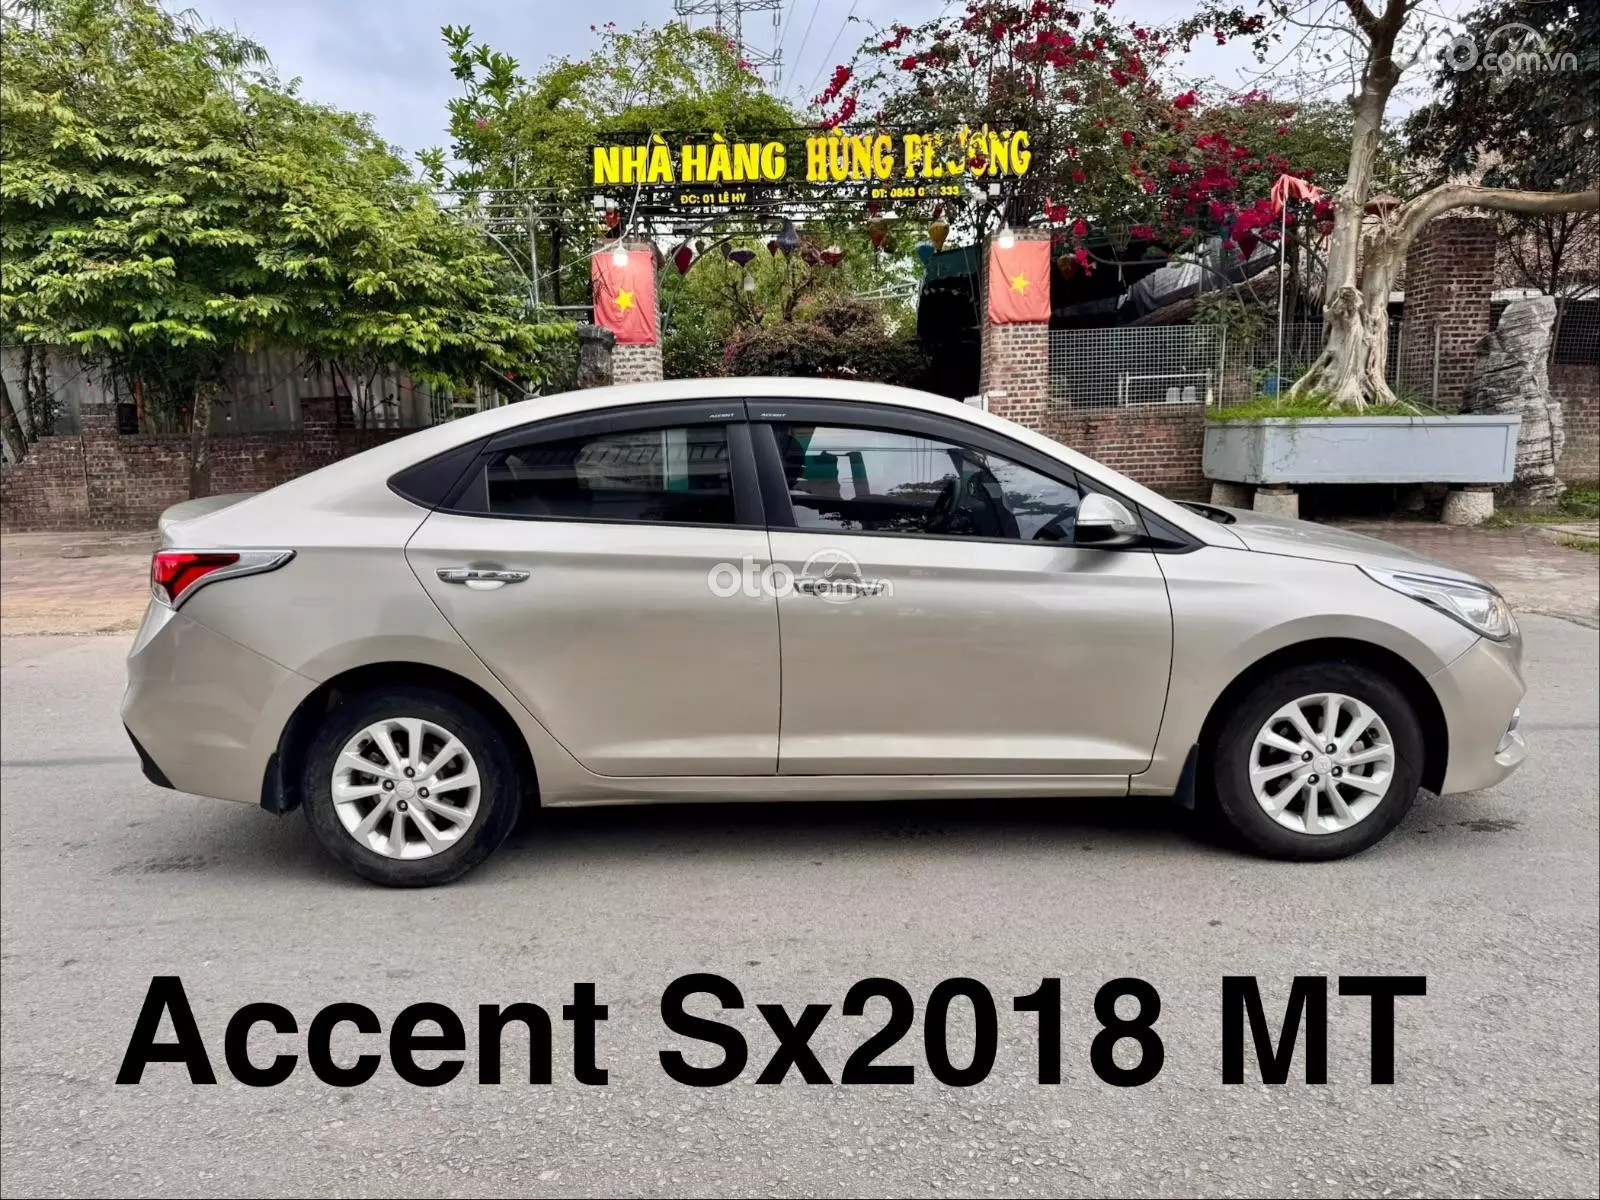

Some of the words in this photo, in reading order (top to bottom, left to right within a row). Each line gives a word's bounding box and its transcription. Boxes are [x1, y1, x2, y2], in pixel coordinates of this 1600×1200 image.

[593, 133, 675, 184] NHÀ
[681, 132, 787, 182] HÀNG
[805, 126, 895, 182] HÙNG
[680, 194, 700, 204] ĐC:
[702, 193, 715, 204] 01
[718, 191, 730, 203] LÊ
[731, 192, 747, 203] HY
